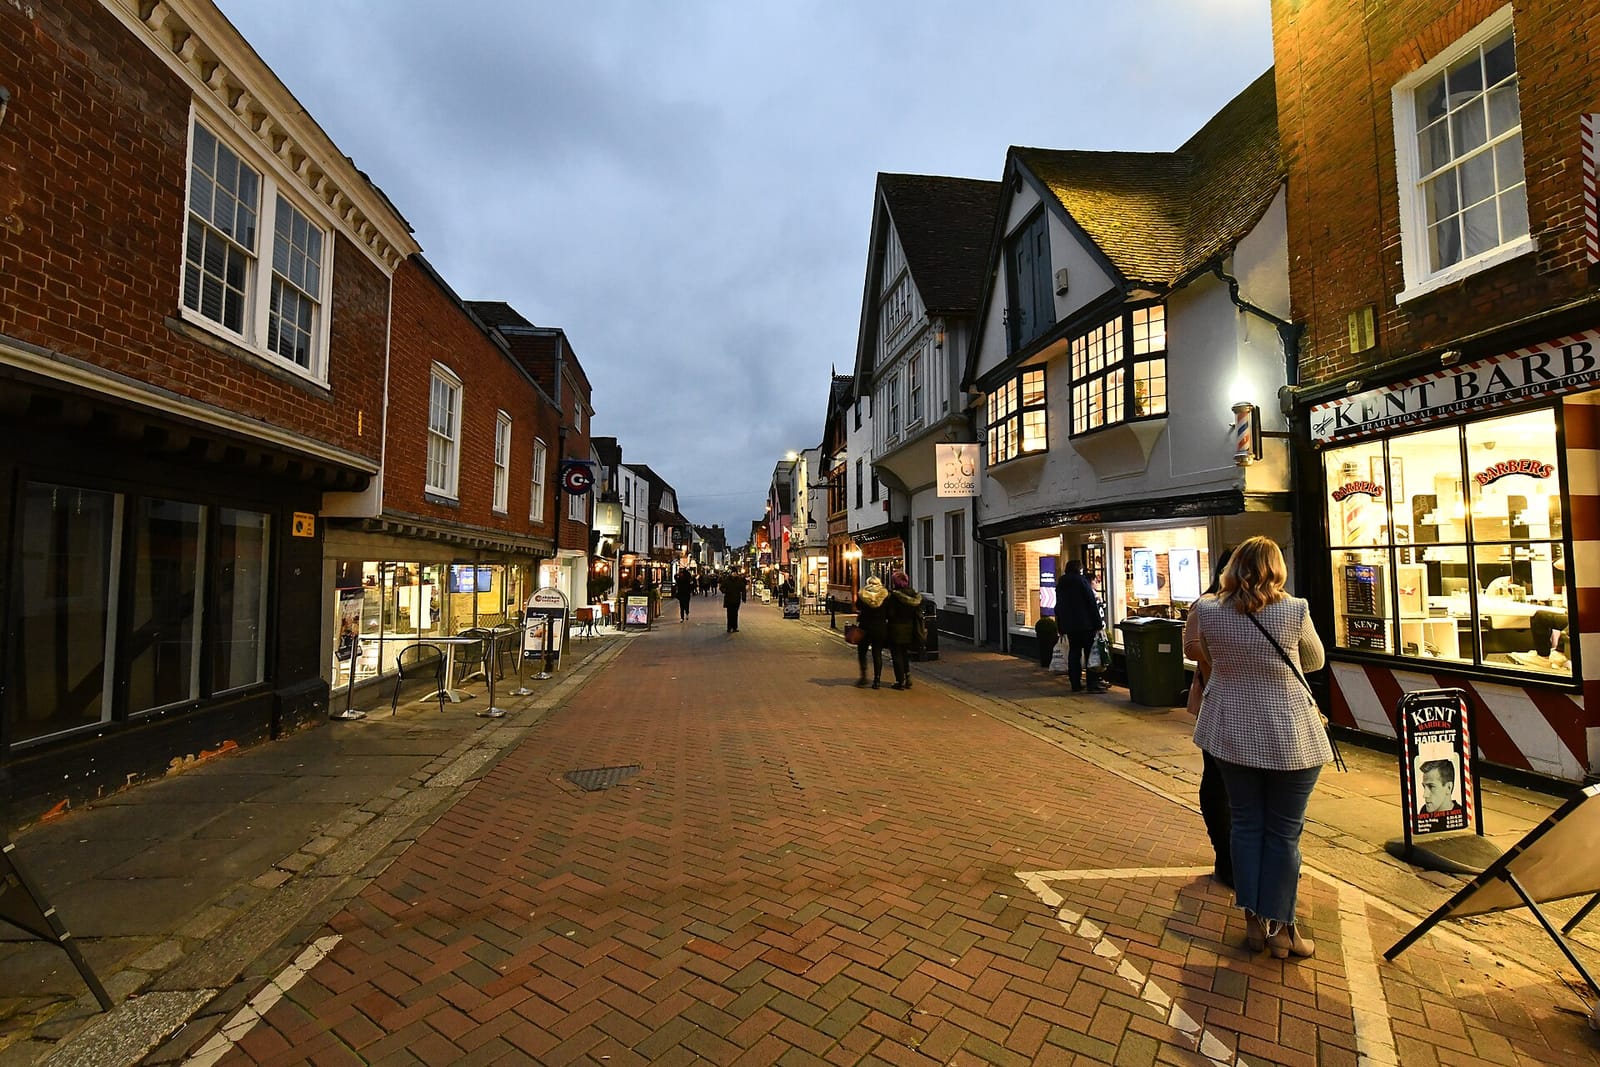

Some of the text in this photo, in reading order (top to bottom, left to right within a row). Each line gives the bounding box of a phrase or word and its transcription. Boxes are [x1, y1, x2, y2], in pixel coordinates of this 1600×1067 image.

[1334, 381, 1435, 428] KENT
[1361, 411, 1433, 431] TRADITIONAL
[1438, 401, 1468, 414] HAIR
[1474, 394, 1498, 405] CUT
[1505, 391, 1513, 400] &
[1521, 382, 1549, 396] HOT
[1475, 459, 1555, 486] BARBERS
[1332, 481, 1384, 502] BARBERS
[1354, 620, 1379, 631] KENT
[1411, 706, 1456, 726] KENT
[1418, 721, 1451, 731] BARBERS
[1414, 733, 1456, 744] HAIR CUT
